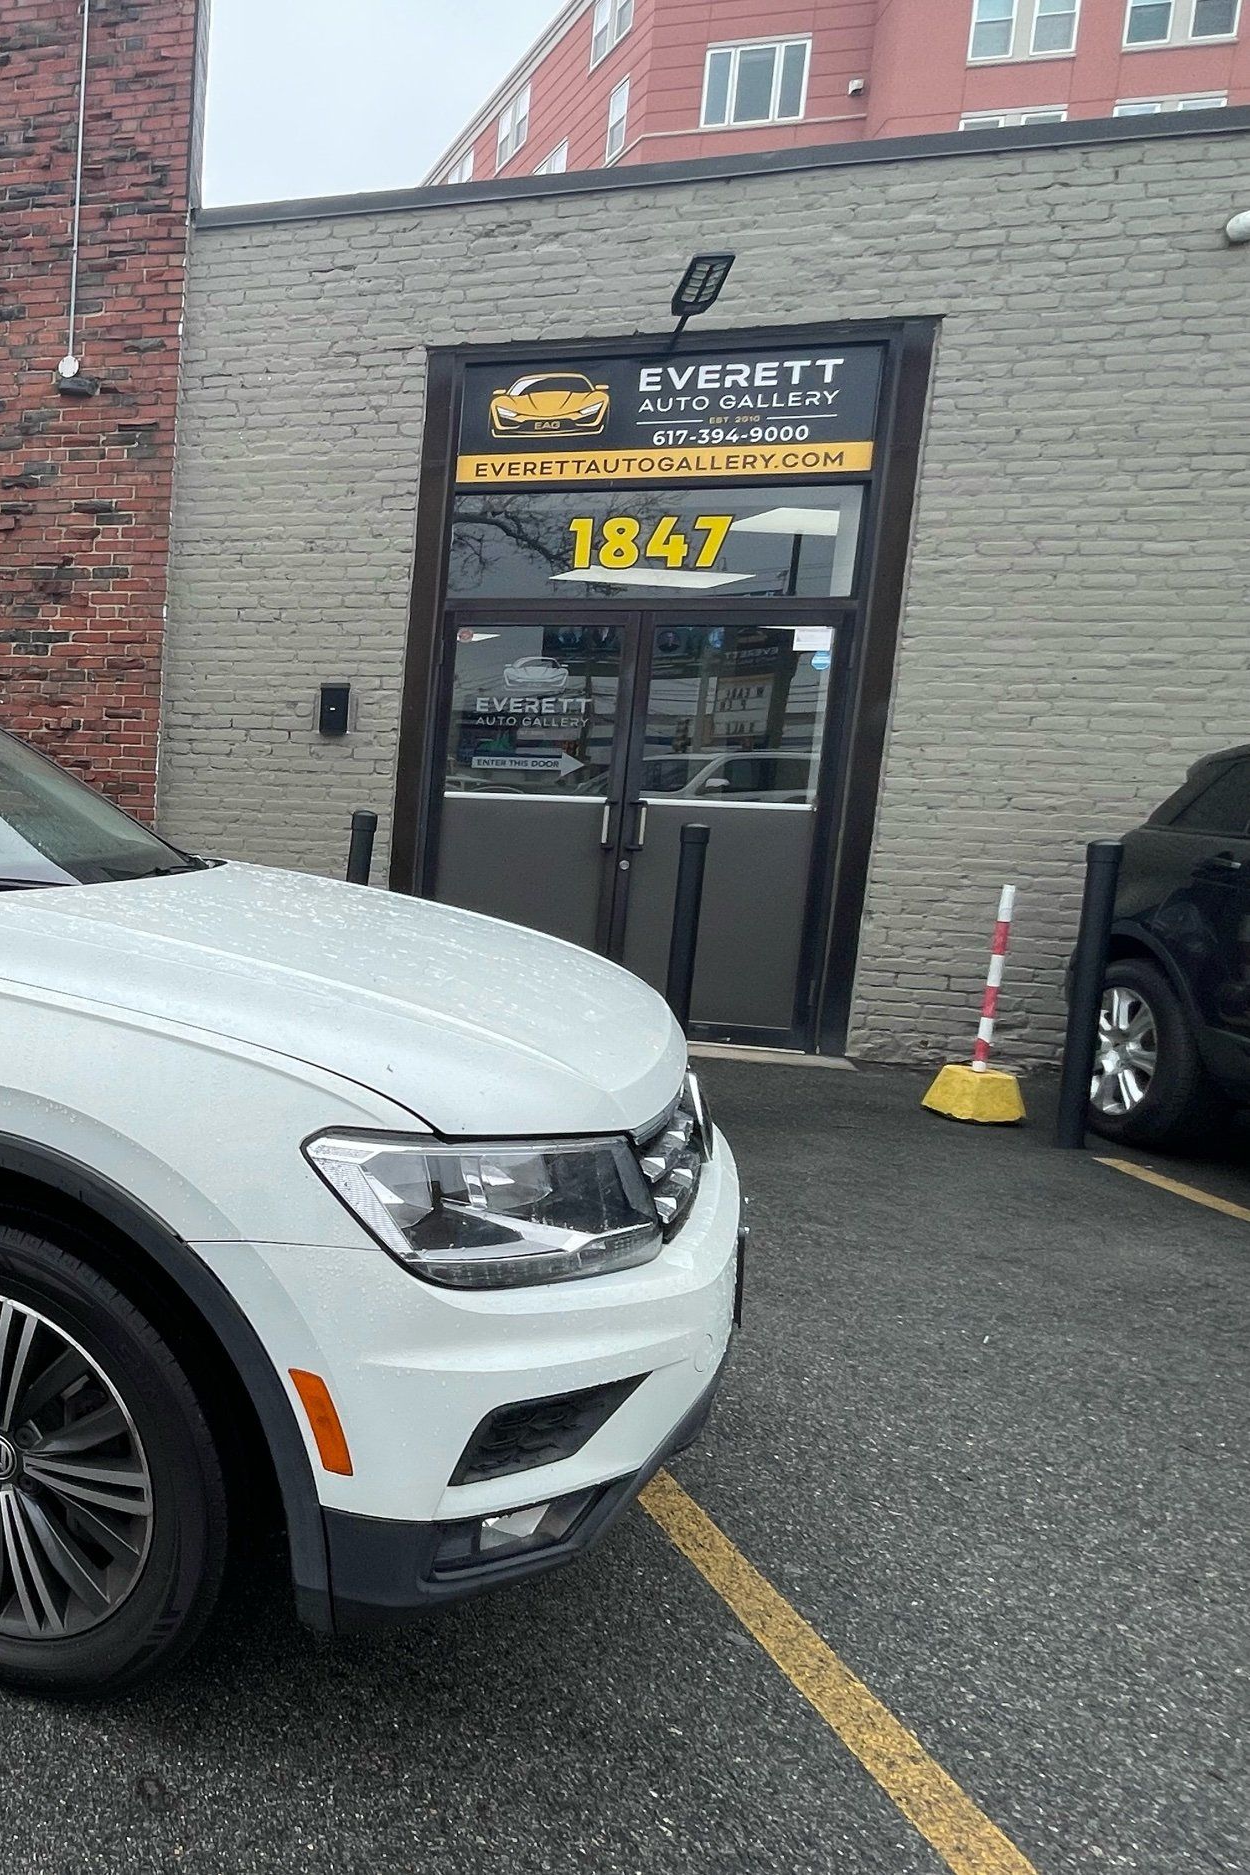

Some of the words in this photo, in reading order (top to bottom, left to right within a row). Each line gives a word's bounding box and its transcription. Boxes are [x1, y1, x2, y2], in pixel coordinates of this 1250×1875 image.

[638, 358, 845, 392] EVERETT
[638, 395, 710, 413] AUTO
[719, 389, 841, 410] GALLERY
[534, 420, 561, 430] EAG
[652, 425, 810, 446] 617-394-9000
[475, 450, 845, 478] EVERETTAUTOGALLERY.COM
[569, 514, 735, 571] 1847
[476, 697, 593, 714] EVERETT
[475, 716, 517, 727] AUTO
[522, 716, 589, 728] GALLERY
[476, 758, 507, 766] ENTER
[510, 759, 529, 767] THIS
[531, 760, 560, 768] DOOR
